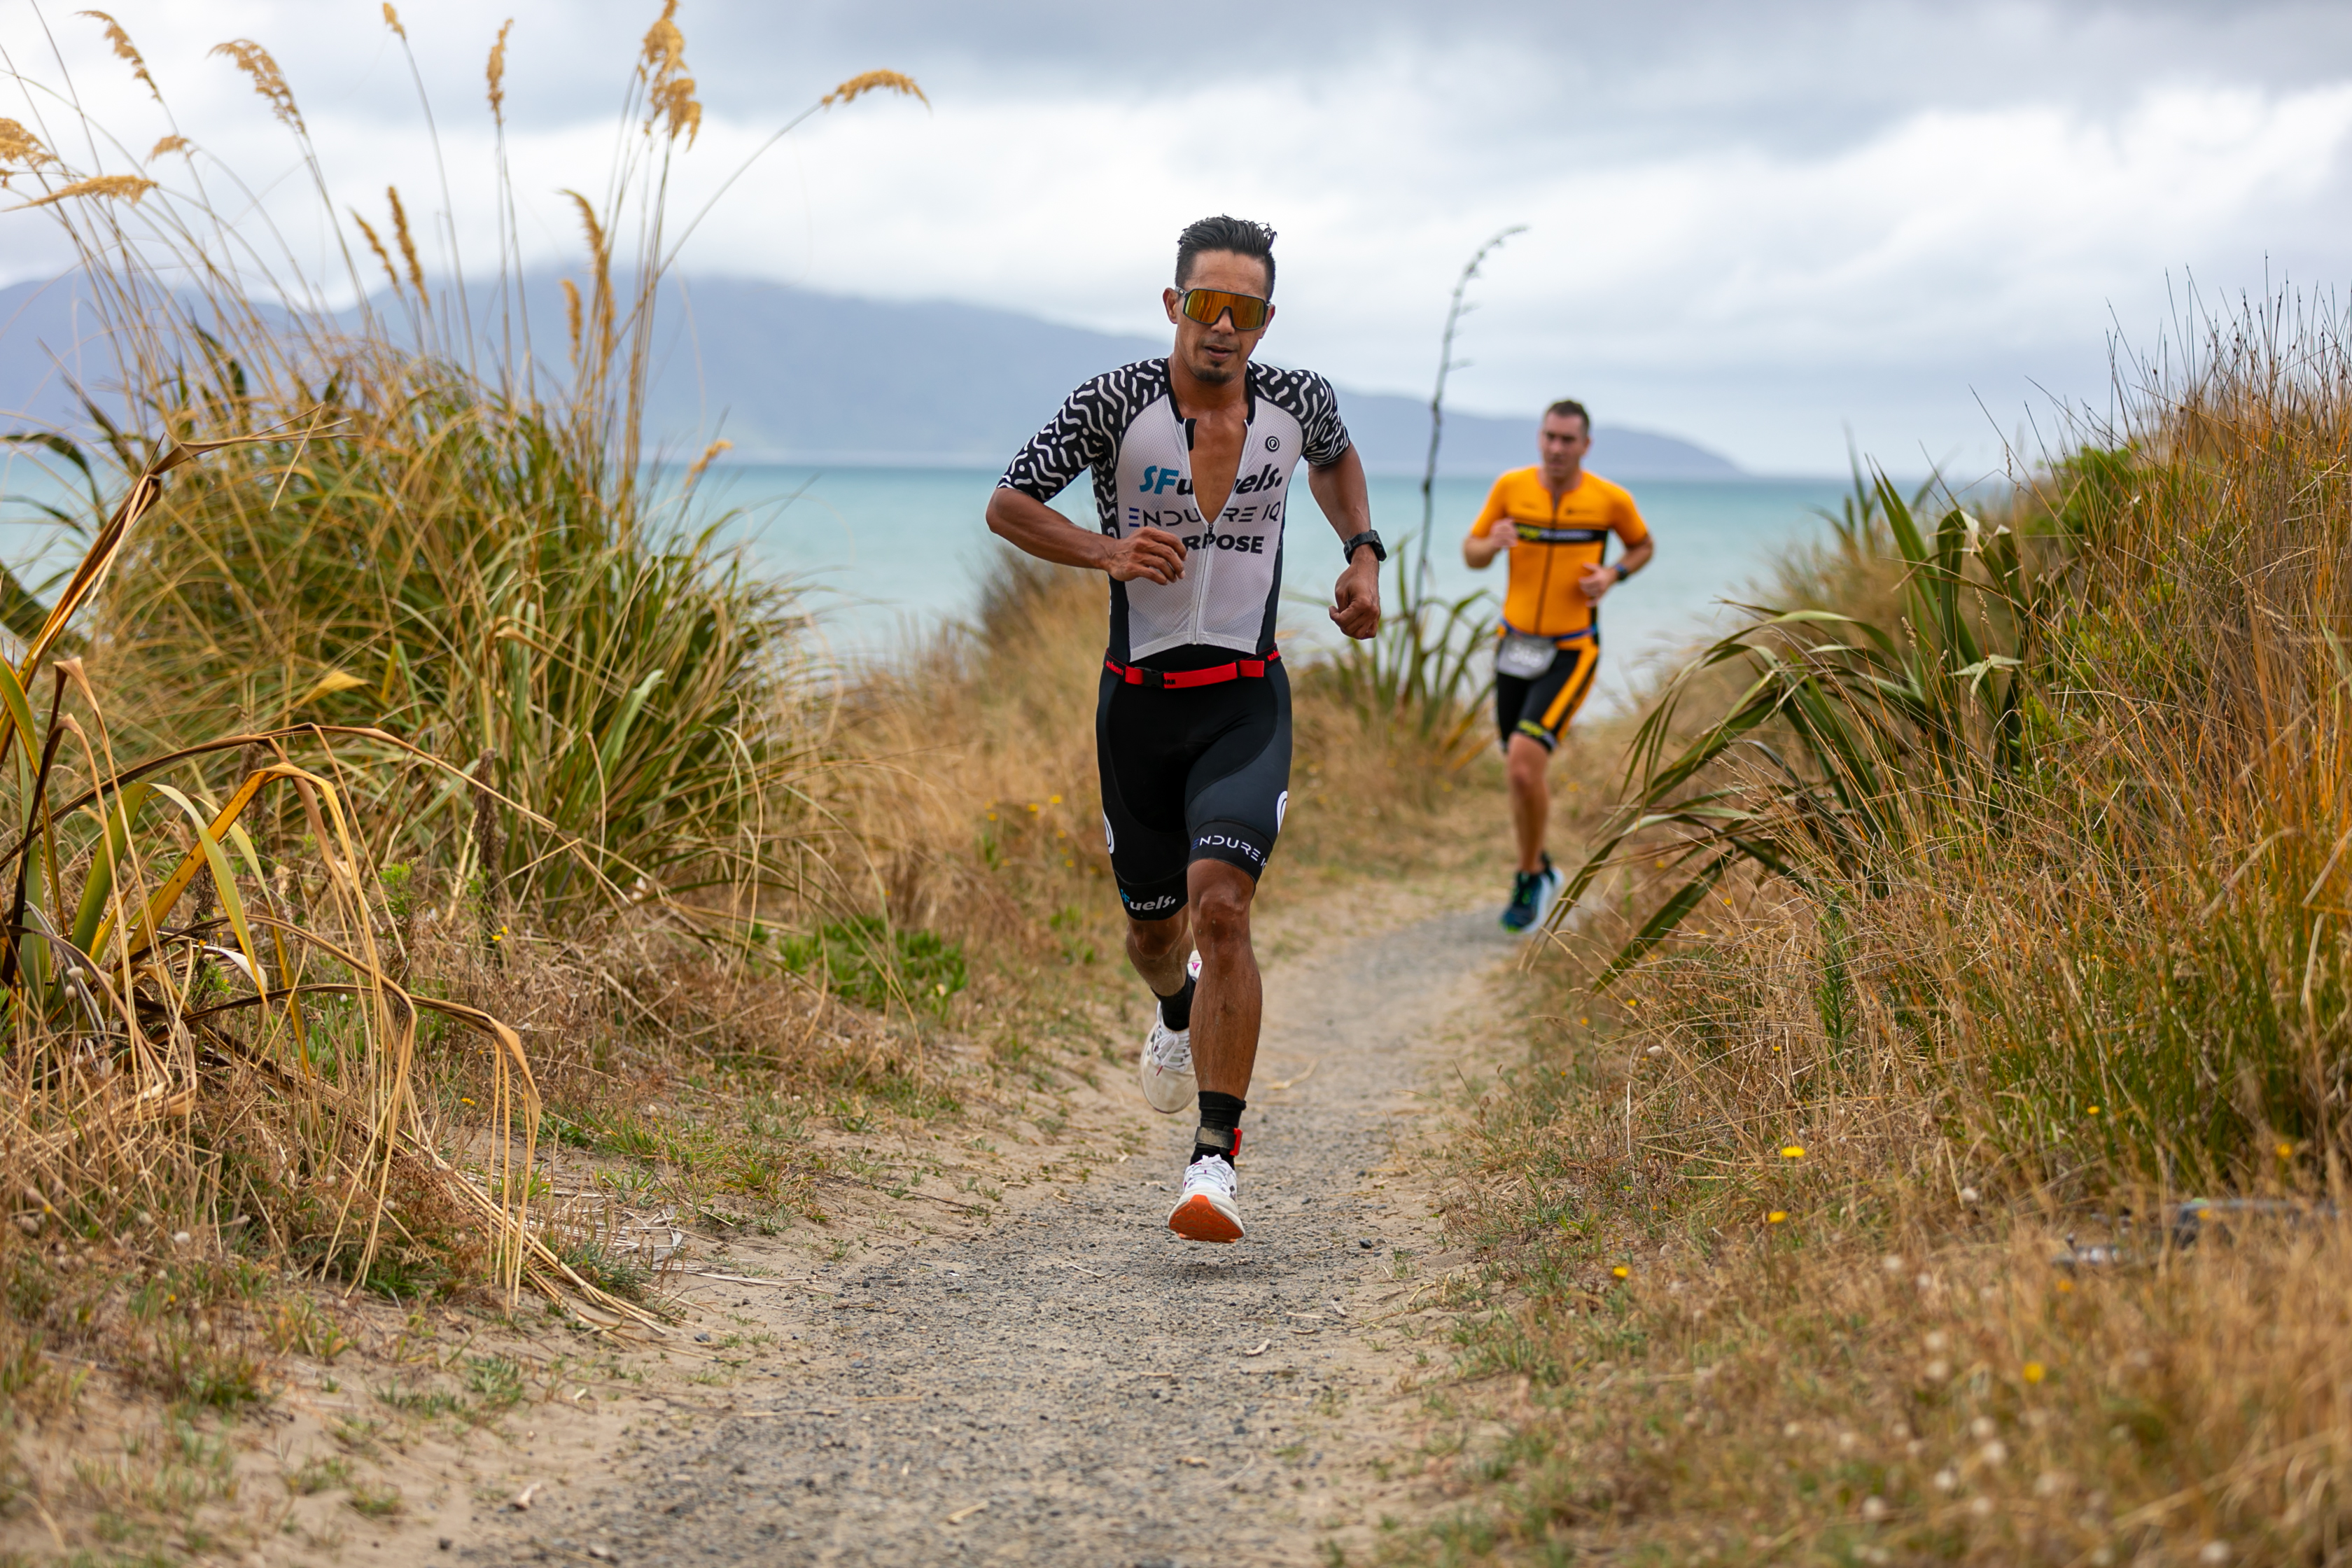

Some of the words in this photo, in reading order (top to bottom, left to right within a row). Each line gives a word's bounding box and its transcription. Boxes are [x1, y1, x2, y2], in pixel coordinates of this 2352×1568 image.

[1128, 506, 1258, 528] ENDURE
[1261, 501, 1281, 522] IQ
[1182, 533, 1265, 554] RPOSE
[1192, 835, 1261, 862] ENDURE
